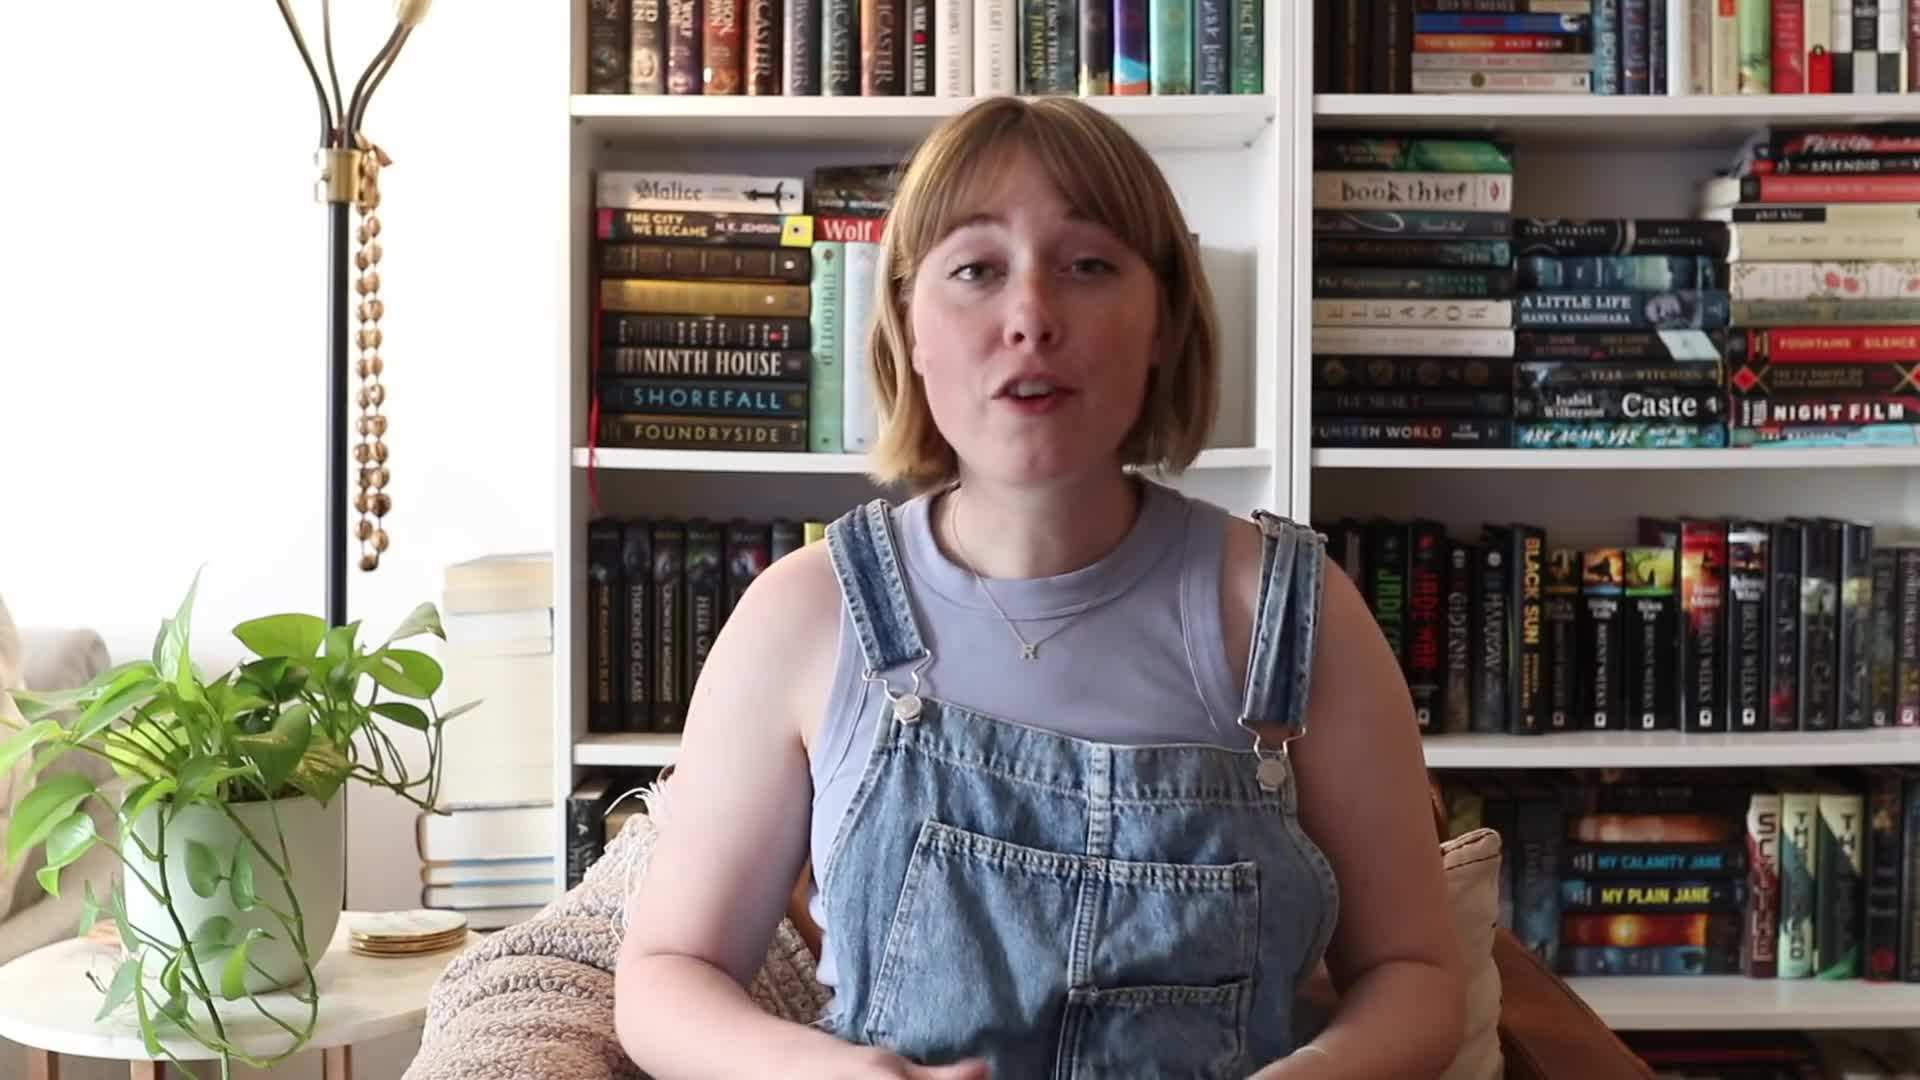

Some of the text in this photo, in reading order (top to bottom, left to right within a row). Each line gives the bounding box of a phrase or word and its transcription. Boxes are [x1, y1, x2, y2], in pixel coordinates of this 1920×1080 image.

[633, 178, 703, 202] Malice
[1341, 178, 1467, 202] book thief
[626, 212, 684, 225] THE CITY
[633, 223, 708, 237] WE BECAME
[823, 219, 872, 241] Wolf
[1520, 296, 1633, 310] A LITTLE LIFE
[644, 350, 709, 375] NINTH
[716, 352, 781, 377] HOUSE
[633, 387, 781, 409] SHOREFALL
[1620, 392, 1698, 418] Caste
[1773, 404, 1843, 421] NIGHT
[1849, 403, 1905, 420] FILM
[634, 424, 779, 442] FOUNDRYSIDE
[1386, 426, 1442, 439] WORLD
[1378, 568, 1402, 623] JADE
[1523, 537, 1541, 645] BLACK SUN
[1449, 592, 1466, 670] GIDEON
[631, 661, 643, 703] GLASS
[1621, 854, 1685, 870] CALAMITY
[1601, 887, 1711, 904] MY PLAIN JANE
